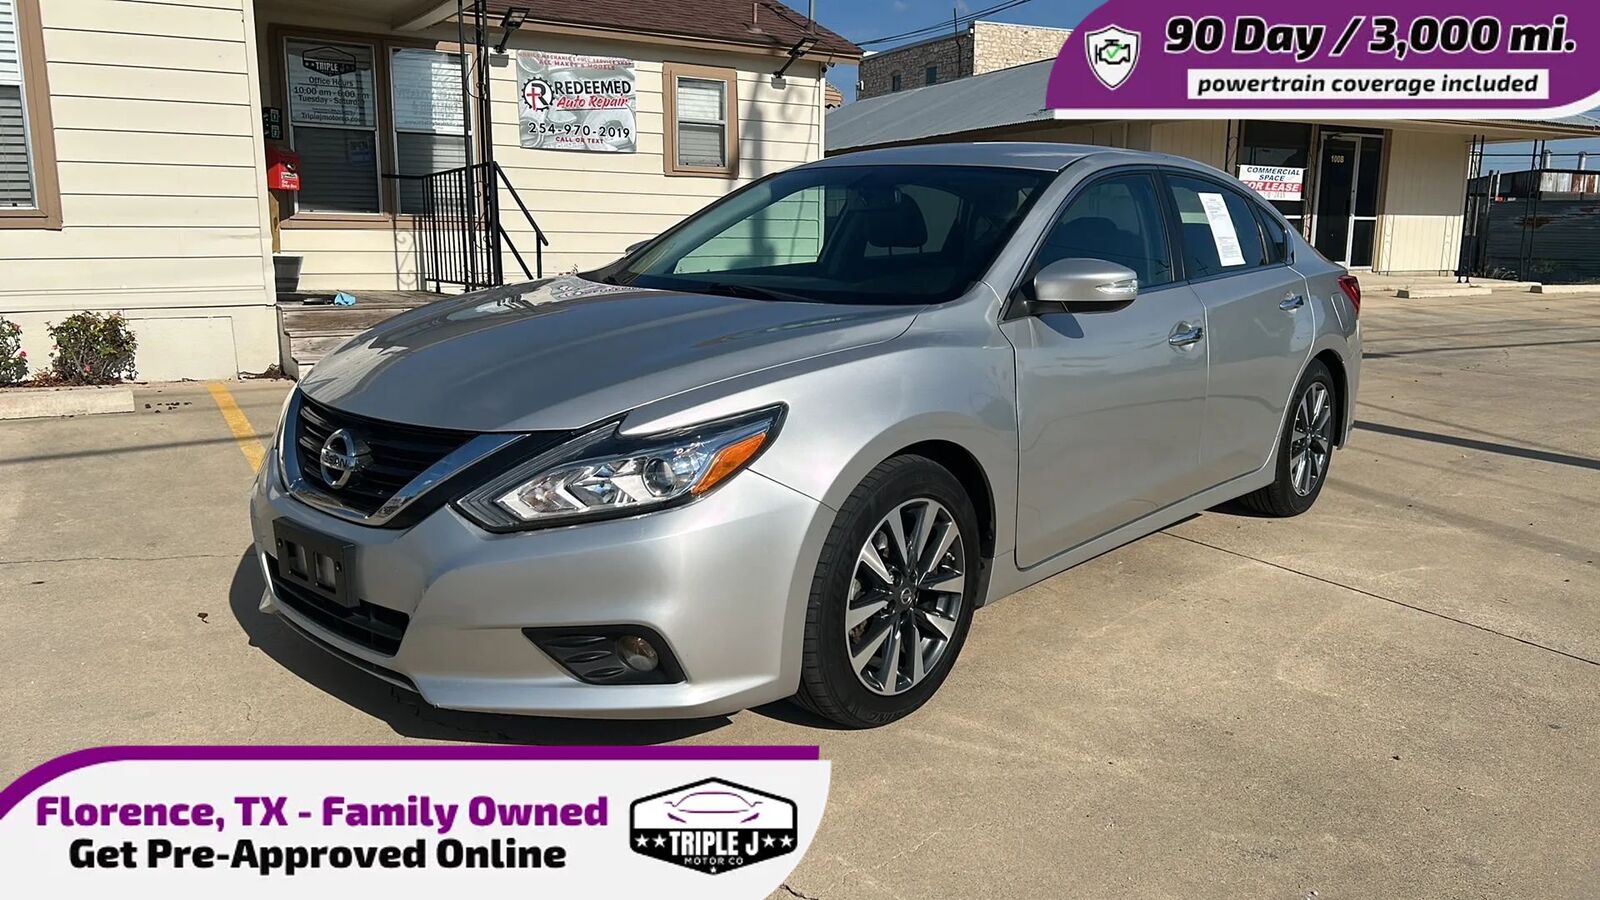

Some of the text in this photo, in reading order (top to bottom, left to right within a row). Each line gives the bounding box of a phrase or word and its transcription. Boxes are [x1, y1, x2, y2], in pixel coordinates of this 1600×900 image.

[316, 61, 339, 71] TRIPLE
[309, 76, 354, 87] Office Hours
[294, 86, 317, 95] 10:00
[555, 80, 631, 95] REDEEMED
[299, 94, 328, 104] Tuesday
[557, 94, 628, 109] Auto Repair
[529, 122, 630, 138] 254-970-2019
[1247, 166, 1301, 176] COMMERCIAL
[1259, 174, 1286, 182] SPACE
[1264, 182, 1300, 192] LEASE
